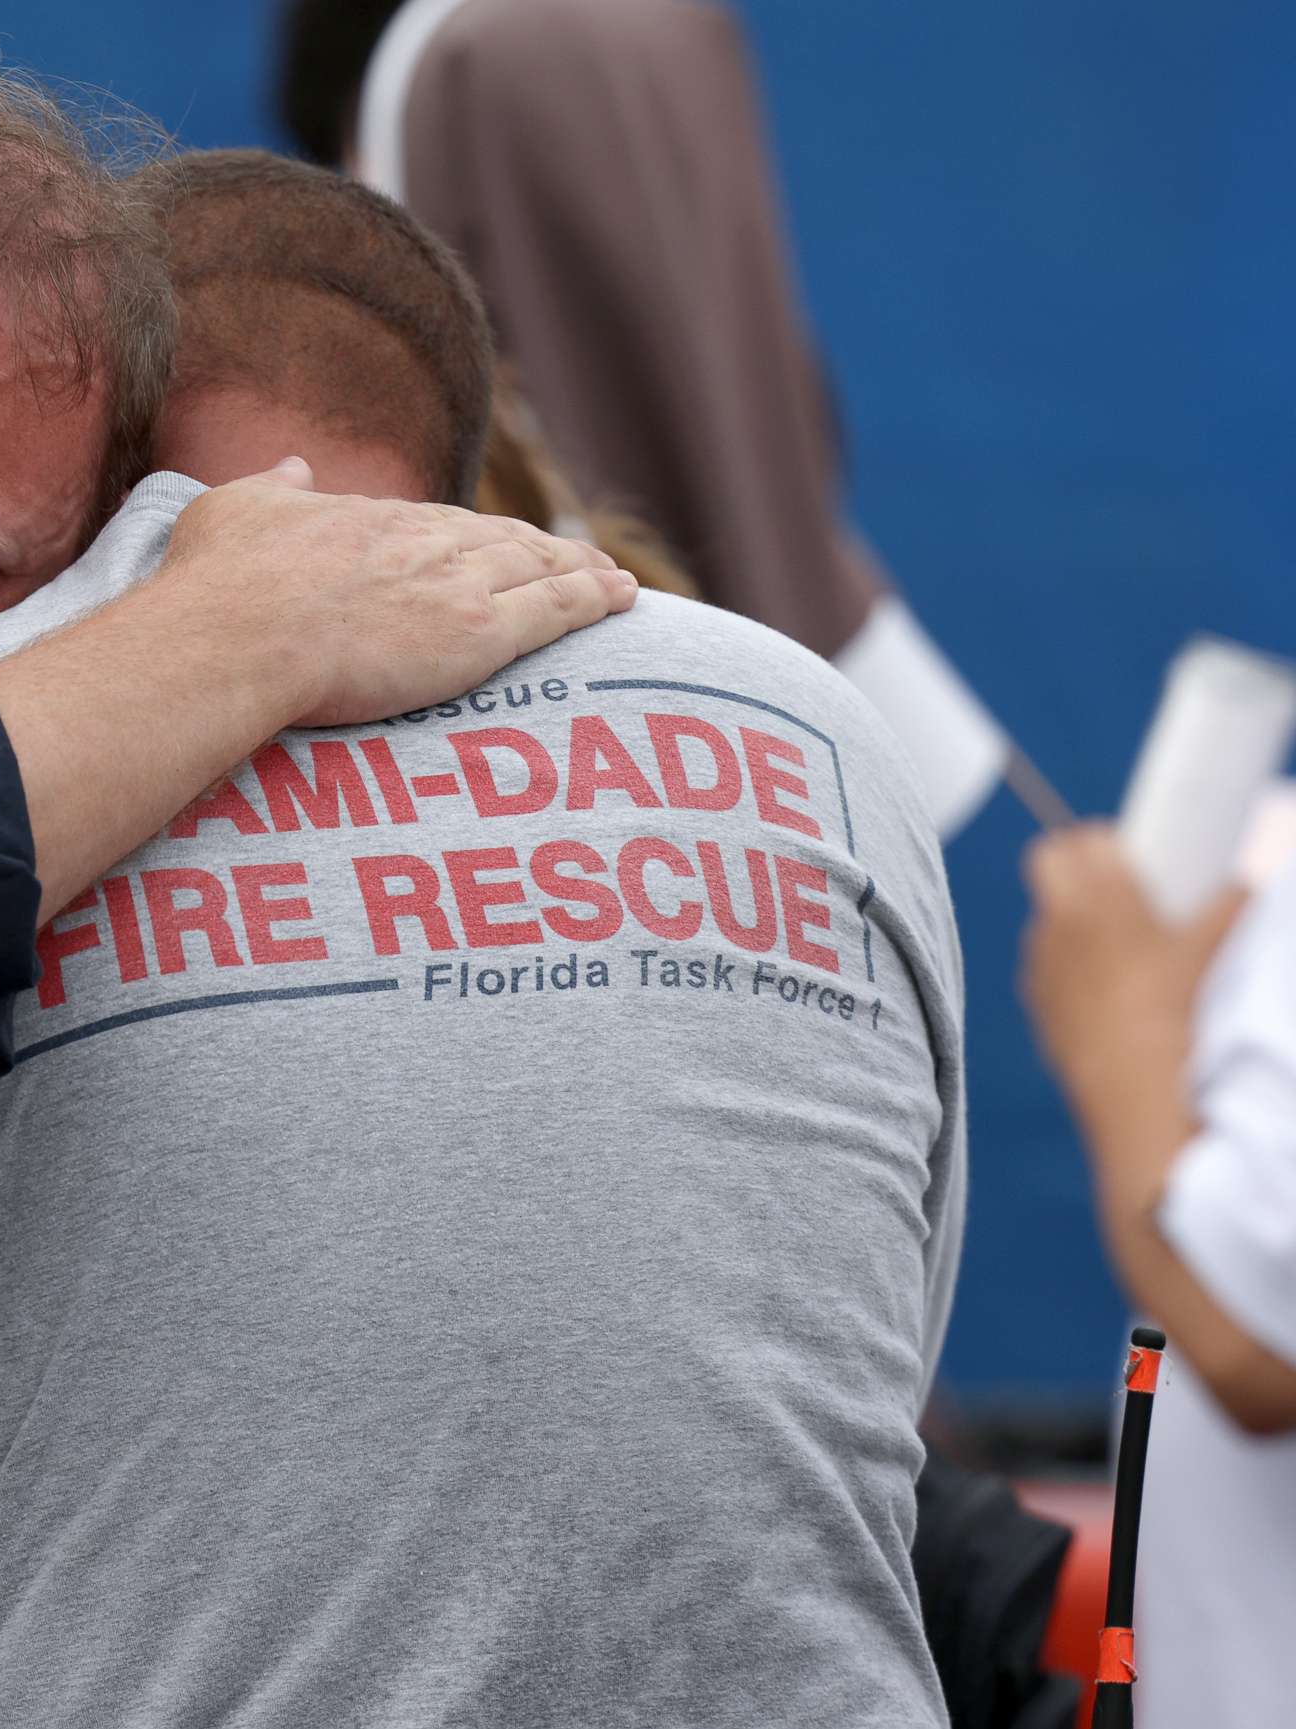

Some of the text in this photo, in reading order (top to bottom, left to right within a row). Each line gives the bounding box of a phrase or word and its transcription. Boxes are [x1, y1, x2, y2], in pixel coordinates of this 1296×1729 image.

[377, 677, 570, 727] escue
[151, 712, 824, 840] AMI-DADE
[35, 835, 842, 1010] FIRE RESCUE
[424, 948, 883, 1031] Florida Task Force 1
